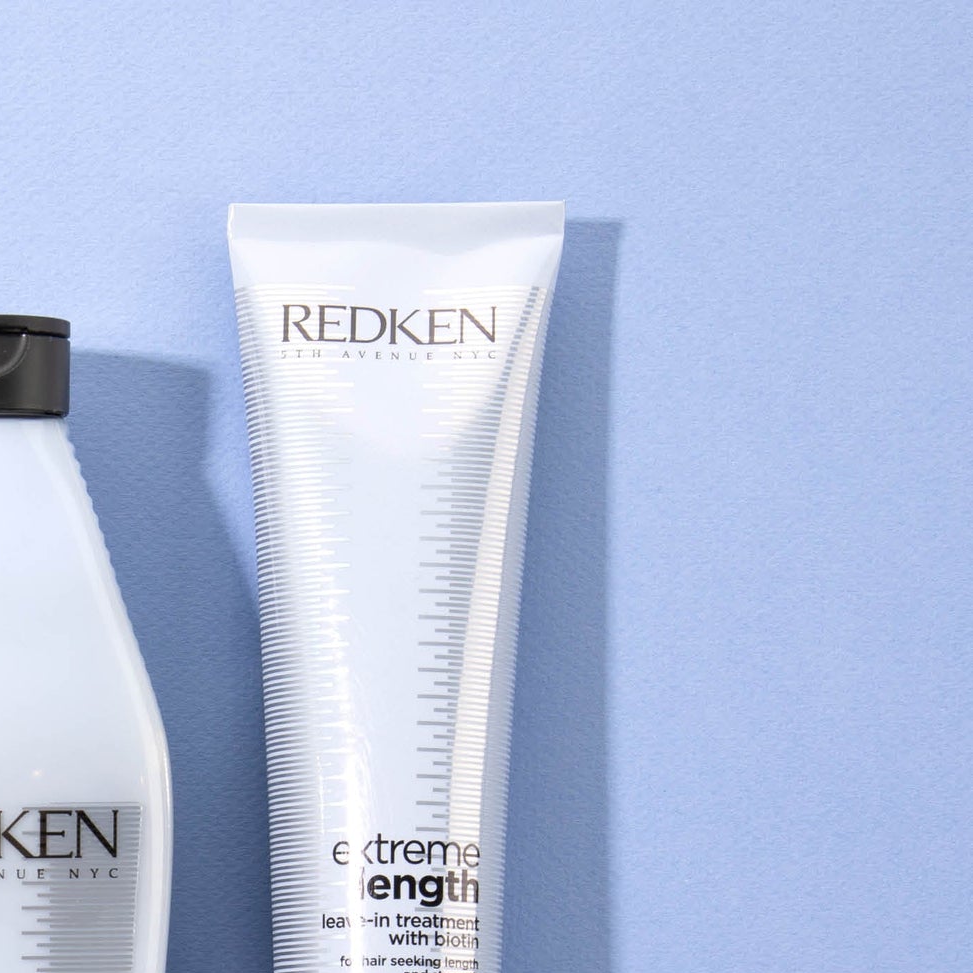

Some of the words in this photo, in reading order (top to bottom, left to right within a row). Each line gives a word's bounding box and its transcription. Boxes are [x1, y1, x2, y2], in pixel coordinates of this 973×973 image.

[282, 304, 497, 346] REDKEN
[281, 349, 322, 360] 5TH
[342, 350, 434, 361] AVENUE
[453, 350, 497, 361] NYC
[69, 867, 119, 880] NYC
[396, 913, 480, 932] treatment
[389, 930, 429, 946] with
[434, 931, 479, 950] biotin
[390, 955, 441, 969] seeking
[444, 957, 479, 971] length
